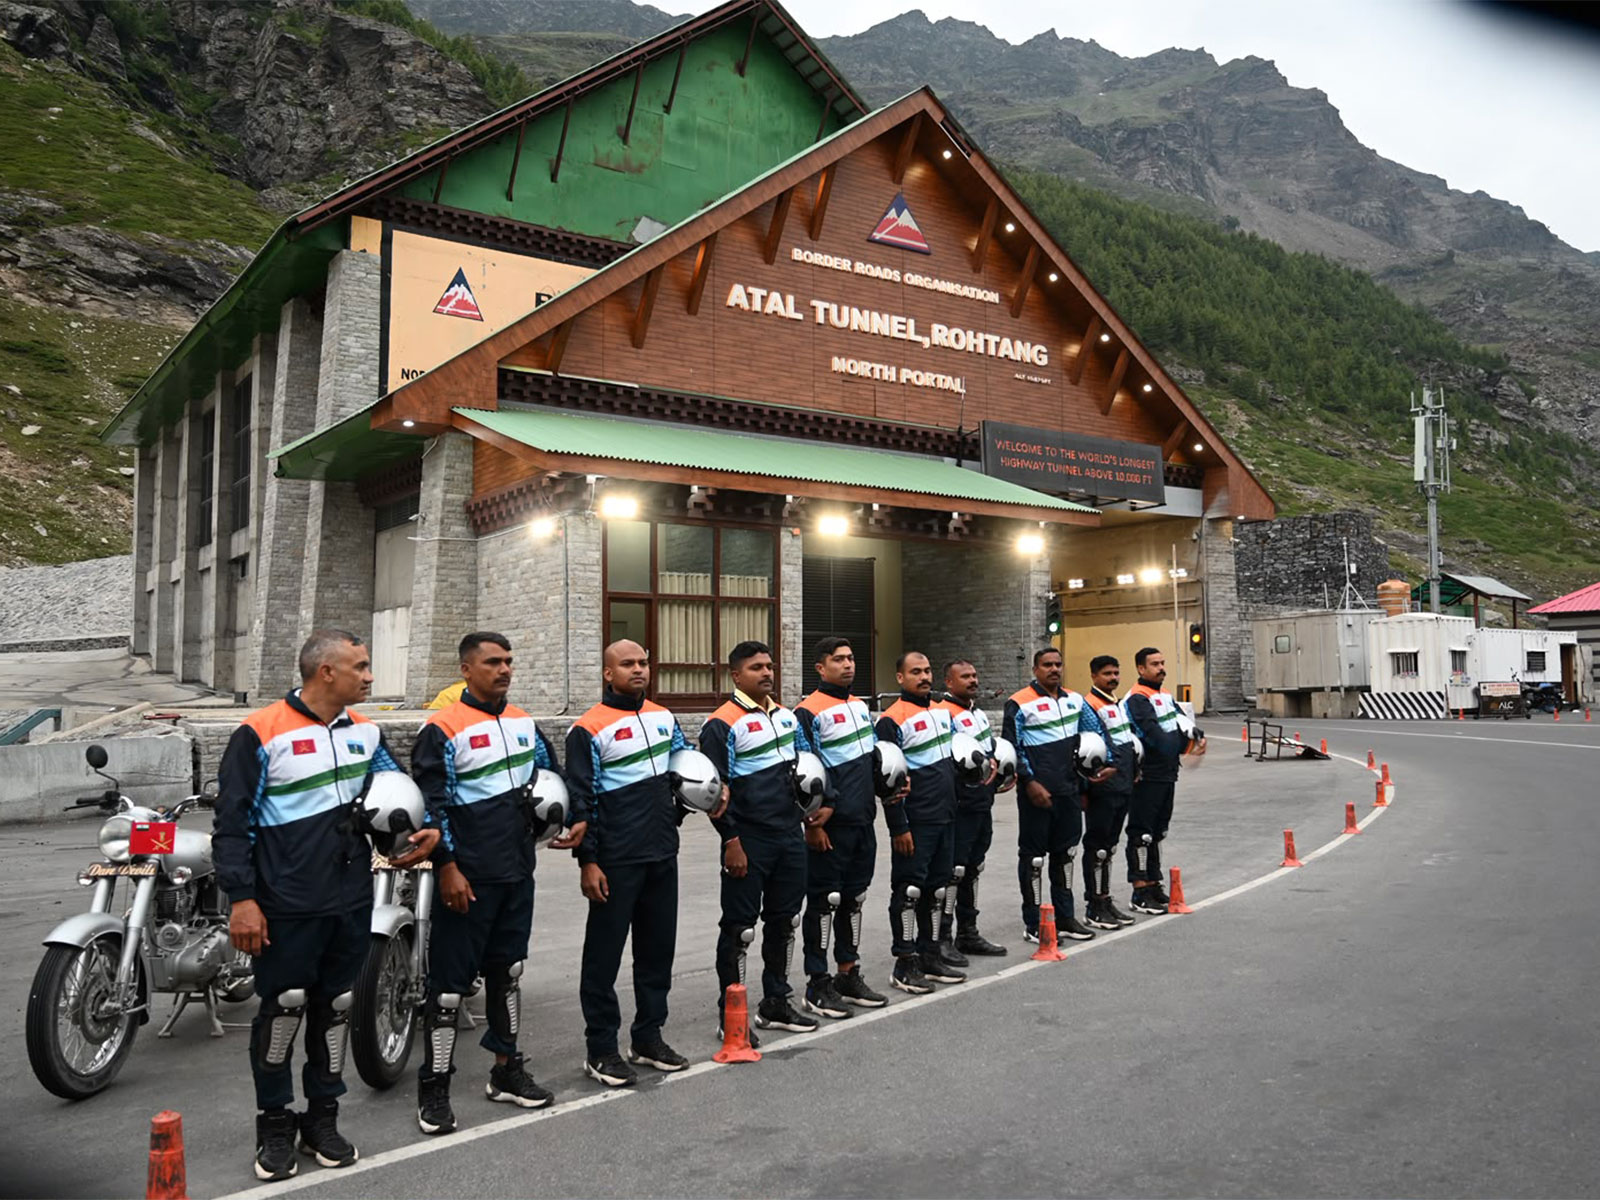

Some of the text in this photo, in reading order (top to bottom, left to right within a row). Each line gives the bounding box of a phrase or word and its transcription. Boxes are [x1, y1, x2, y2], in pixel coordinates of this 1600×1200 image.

[791, 248, 1000, 304] BORDER ROADS ORGANISATION
[726, 283, 804, 320] ATAL
[831, 356, 966, 393] NORTH PORTAL
[994, 438, 1155, 470] WELCOME TO THE WORLD'S LONGEST
[1000, 456, 1153, 485] HIGHWAY TUNNEL ABOVE 10,000 FT
